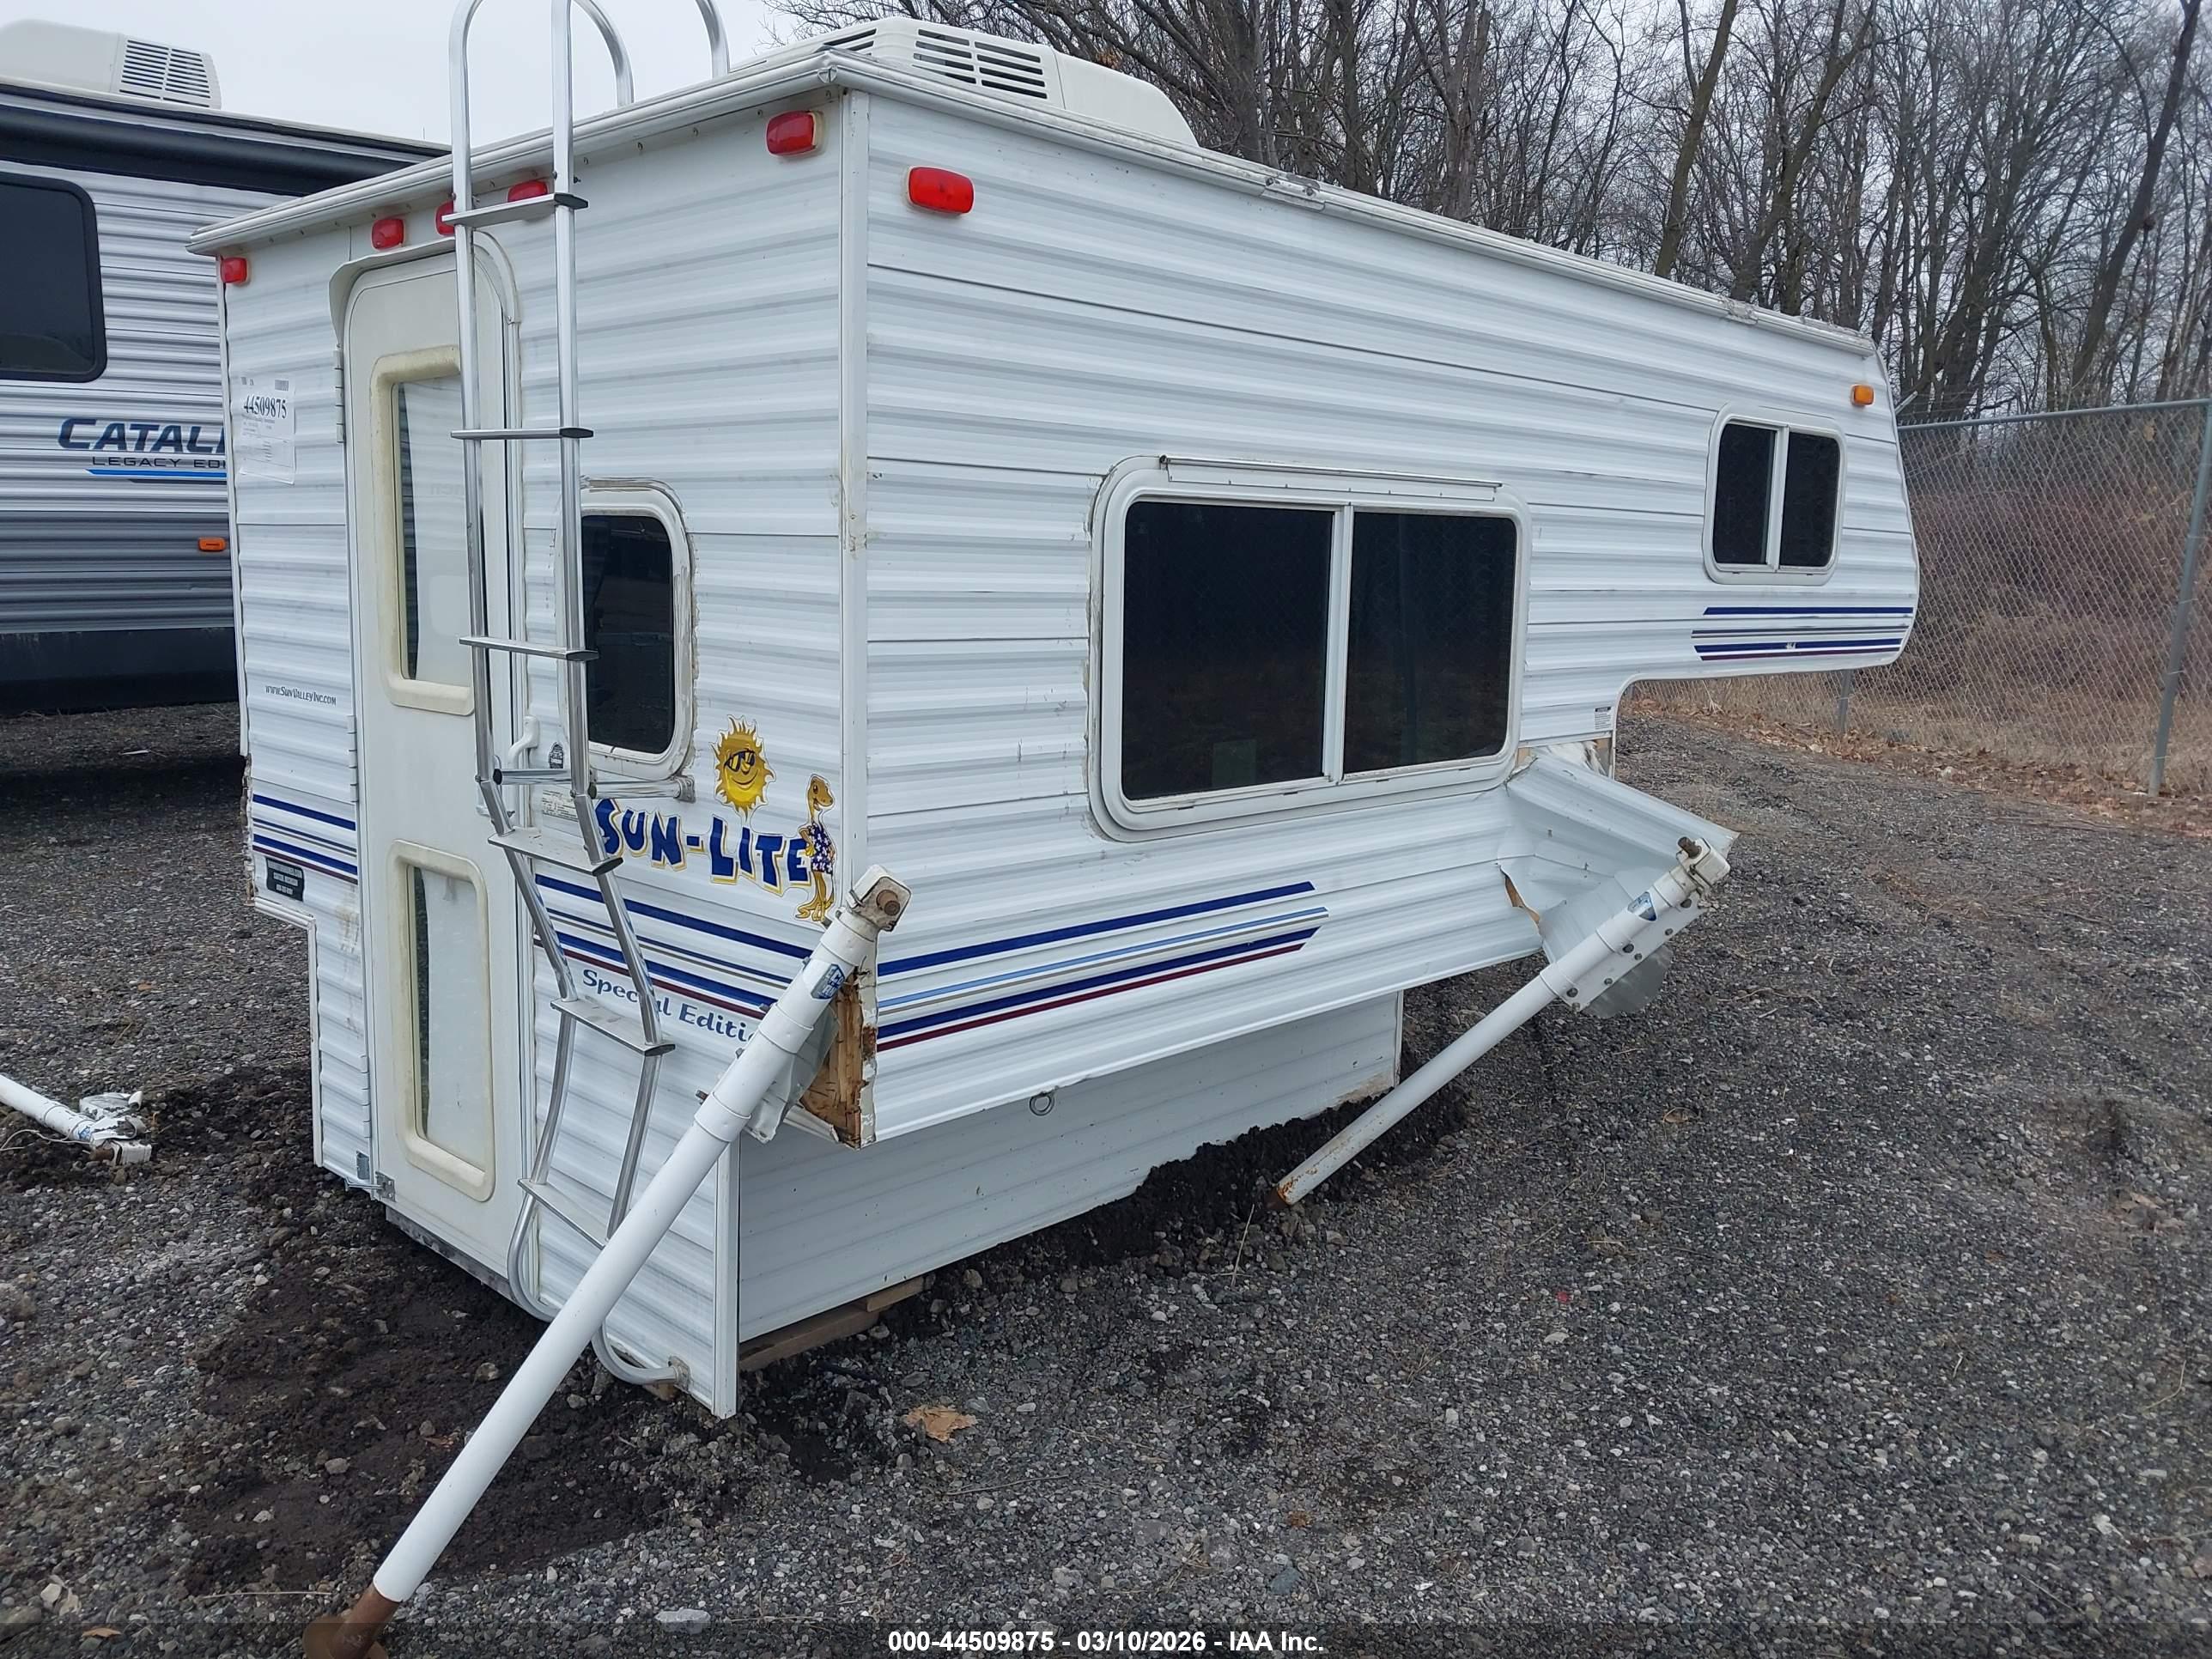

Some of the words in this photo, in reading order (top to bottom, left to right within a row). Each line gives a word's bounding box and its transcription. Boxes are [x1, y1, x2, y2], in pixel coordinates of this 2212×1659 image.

[243, 394, 288, 420] 44509875
[92, 456, 181, 468] LEGACY
[594, 798, 811, 895] SUN-LITE
